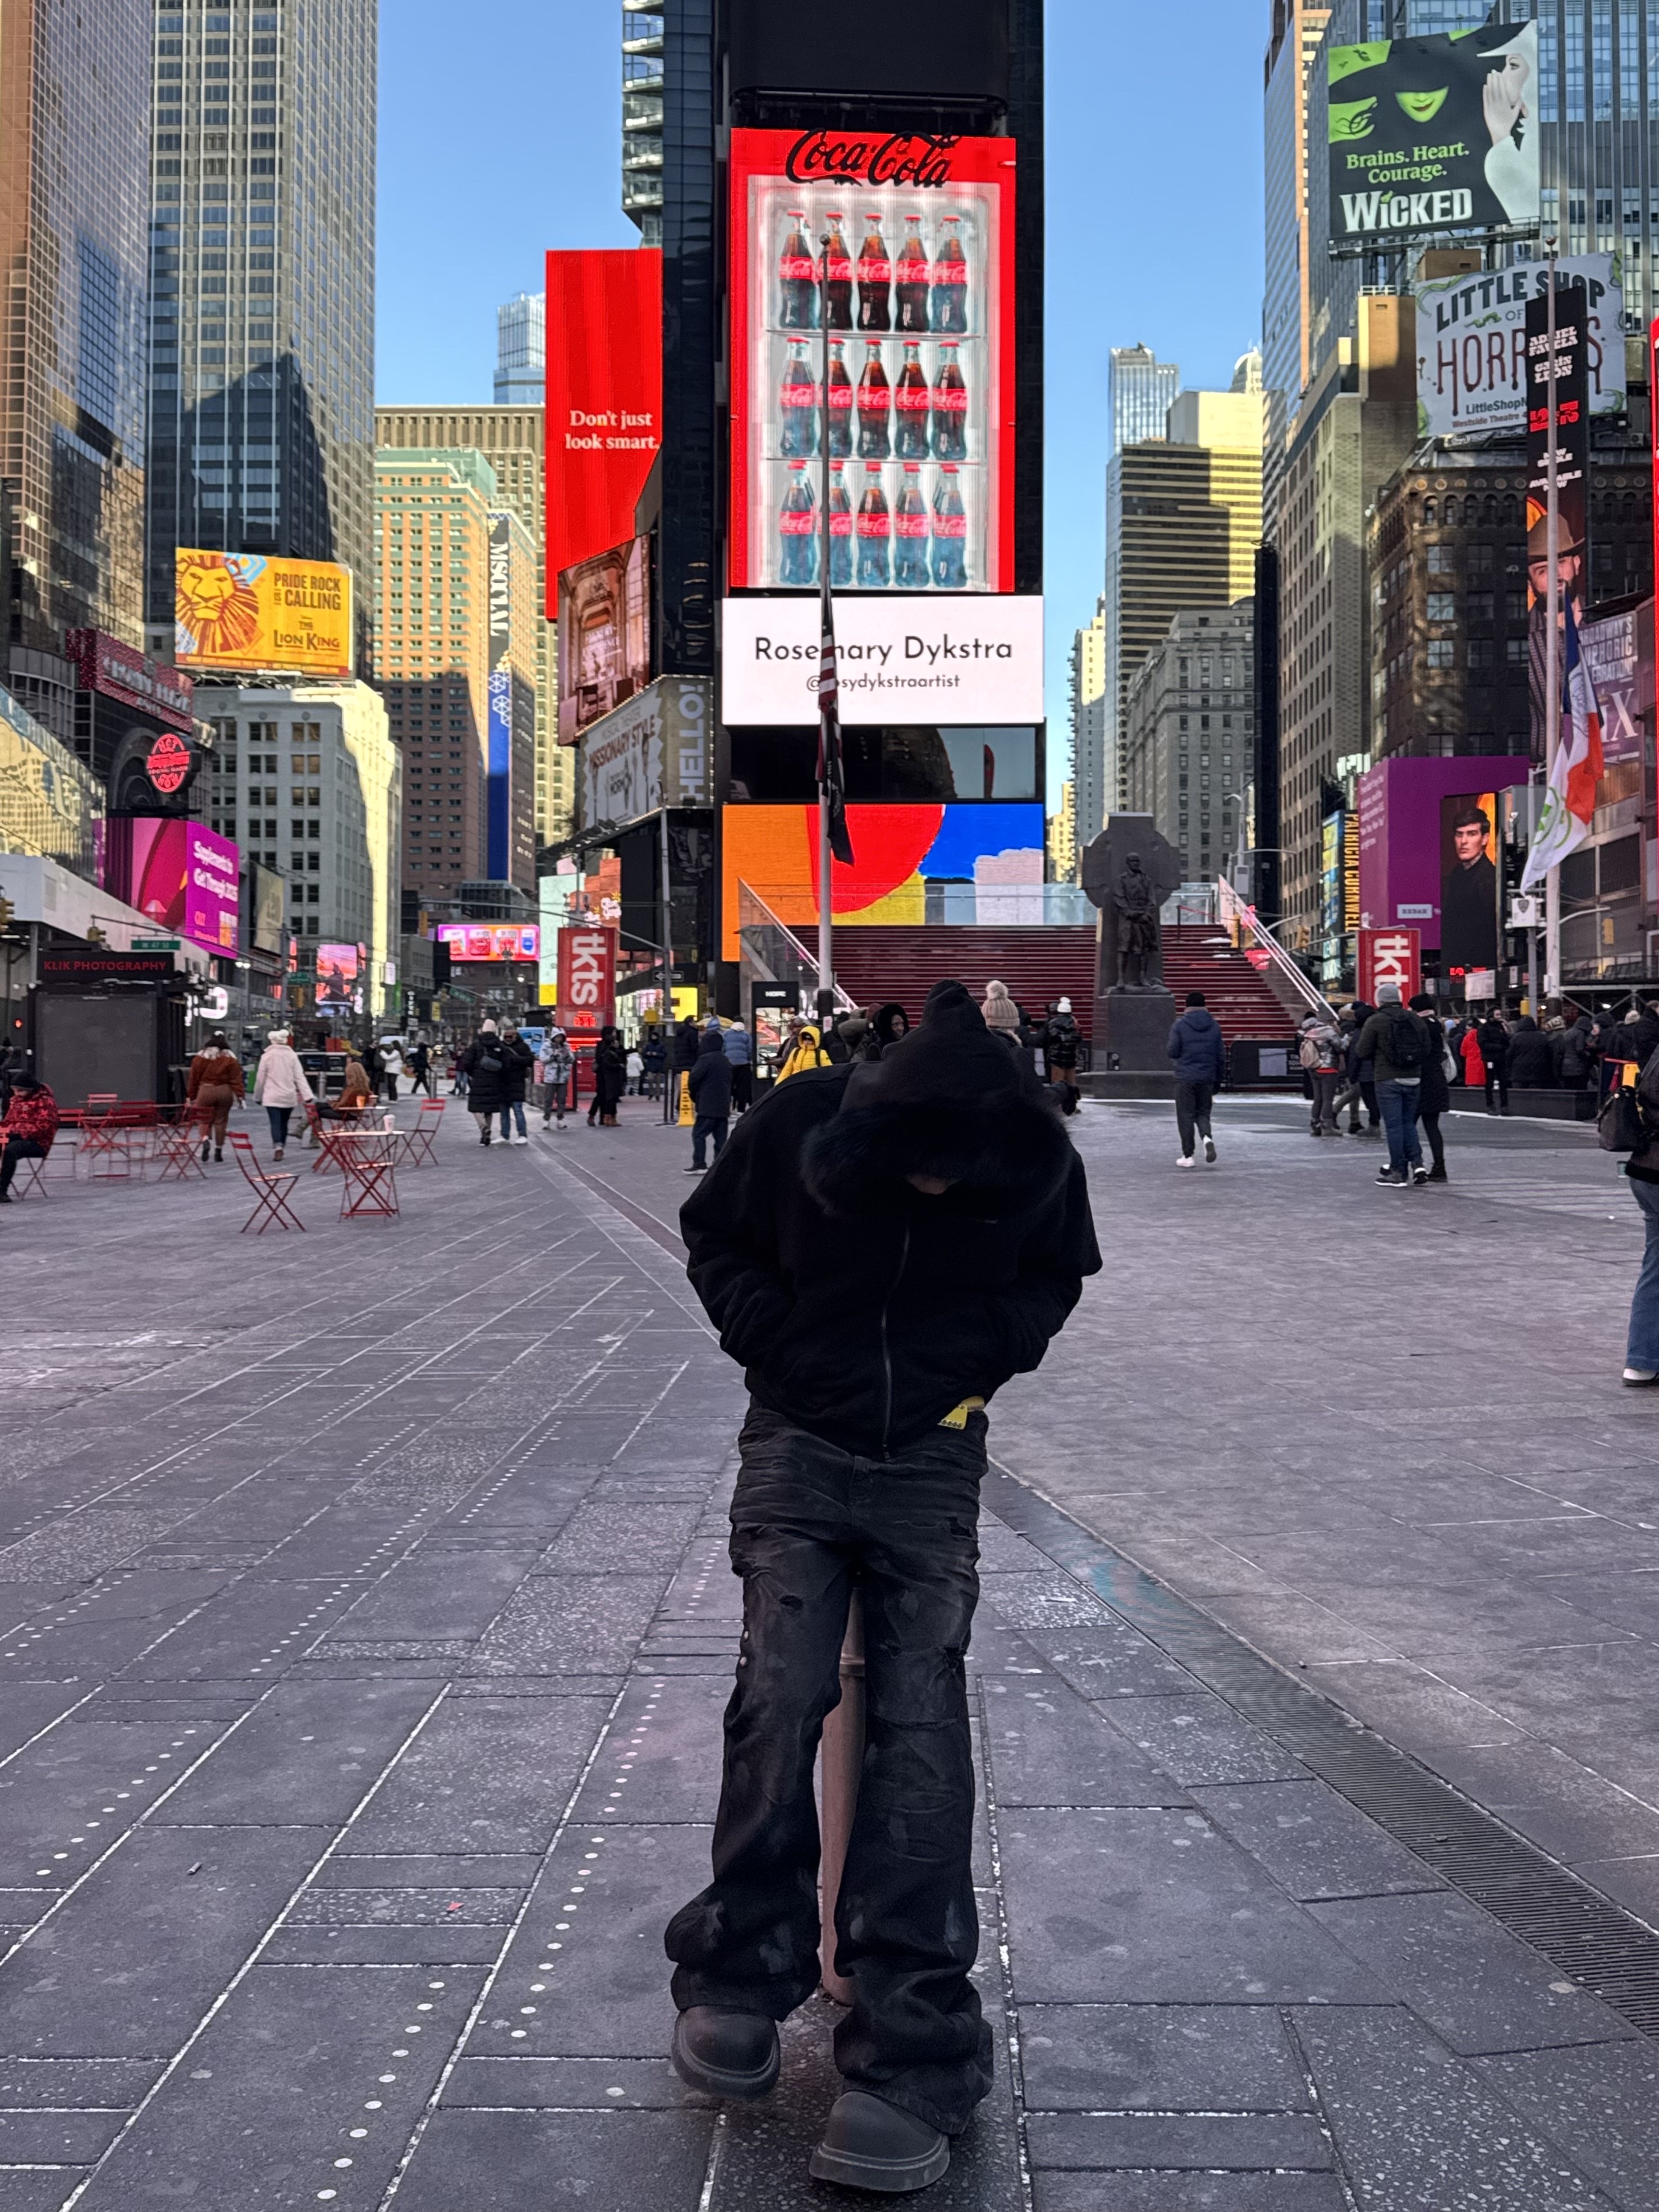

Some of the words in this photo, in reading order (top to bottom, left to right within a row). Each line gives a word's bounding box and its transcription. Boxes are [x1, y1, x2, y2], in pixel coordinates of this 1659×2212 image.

[1346, 149, 1410, 169] Brains.
[1413, 141, 1469, 162] Heart.
[1368, 164, 1447, 184] Courage.
[1437, 271, 1528, 333] LITTLE
[1505, 309, 1523, 321] OF
[1529, 326, 1577, 347] ADIEL
[569, 409, 618, 426] Don't
[620, 410, 653, 431] just
[1490, 412, 1519, 423] Theatre
[565, 433, 603, 449] look
[606, 435, 660, 449] smart.
[274, 572, 308, 590] PRIDE
[310, 576, 341, 593] ROCK
[285, 589, 341, 611] CALLING
[273, 630, 304, 648] LION
[306, 632, 340, 651] KING
[755, 636, 893, 666] Roseary
[904, 634, 1012, 666] Dykstra
[806, 673, 960, 692] @sydykstraartist
[631, 714, 656, 749] STYLE
[679, 684, 703, 800] HELLO!
[44, 961, 70, 970] KLIK
[74, 961, 167, 971] PHOTOGRAPHY
[571, 933, 607, 1006] tkts
[1373, 934, 1411, 1008] tkt
